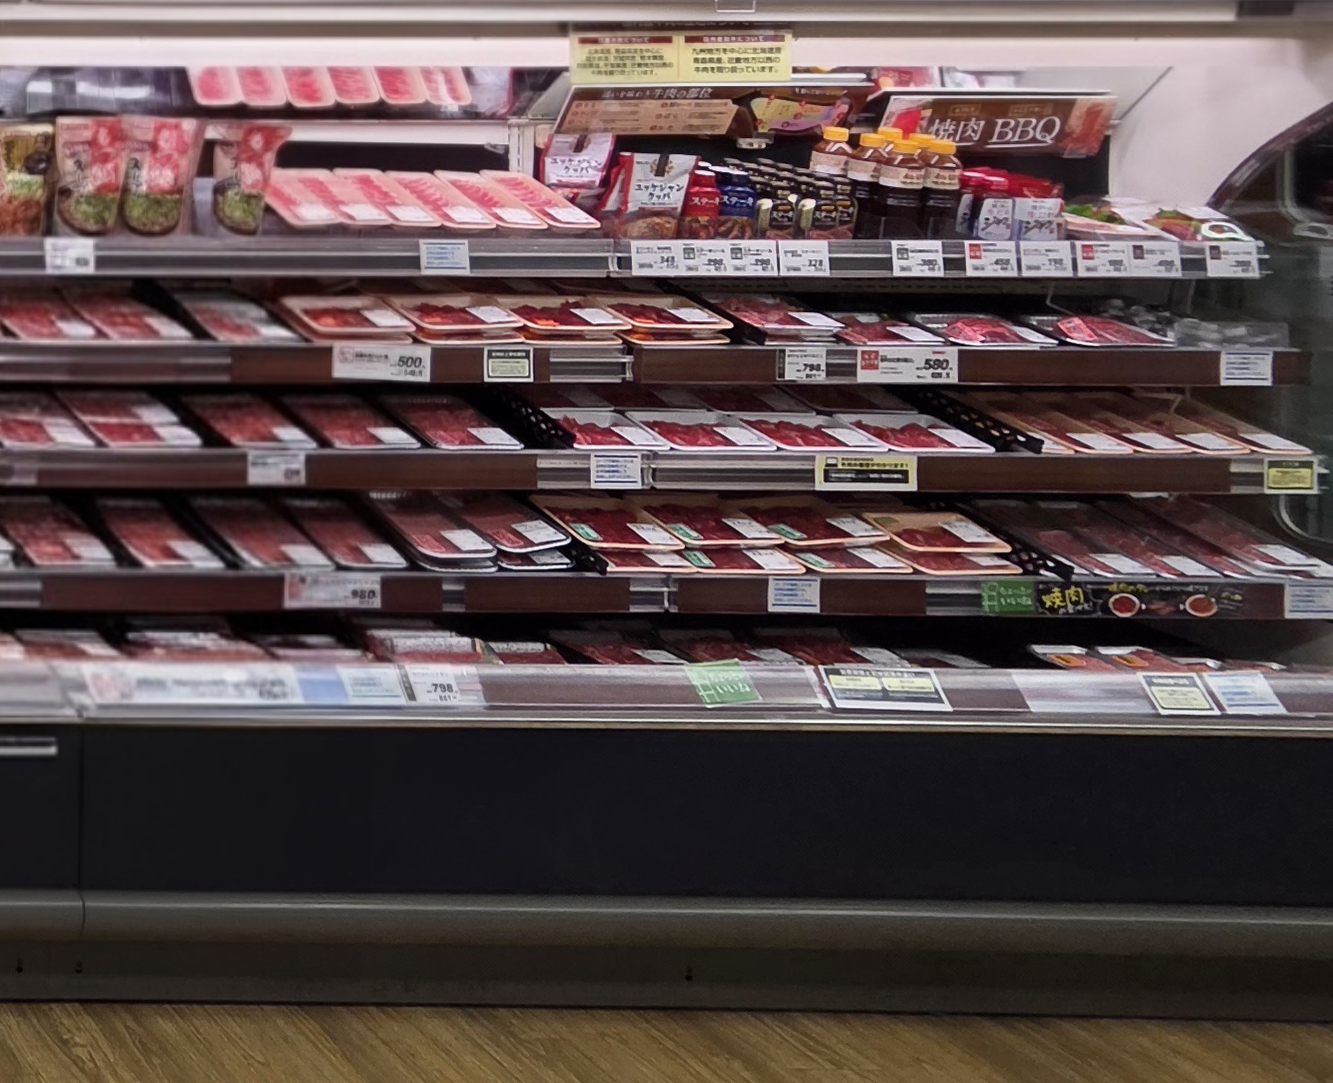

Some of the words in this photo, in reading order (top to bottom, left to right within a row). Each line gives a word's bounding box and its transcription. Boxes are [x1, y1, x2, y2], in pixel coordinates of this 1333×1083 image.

[653, 87, 714, 100] 牛肉の部位
[929, 116, 986, 142] 焼肉
[988, 116, 1062, 144] BBQ
[634, 182, 685, 192] ユッケジャン
[647, 191, 673, 201] クッパ
[397, 355, 423, 369] 500
[801, 363, 822, 372] 798
[923, 358, 950, 371] 580
[351, 589, 376, 600] 980
[1041, 585, 1085, 609] 焼肉
[431, 682, 454, 694] 798
